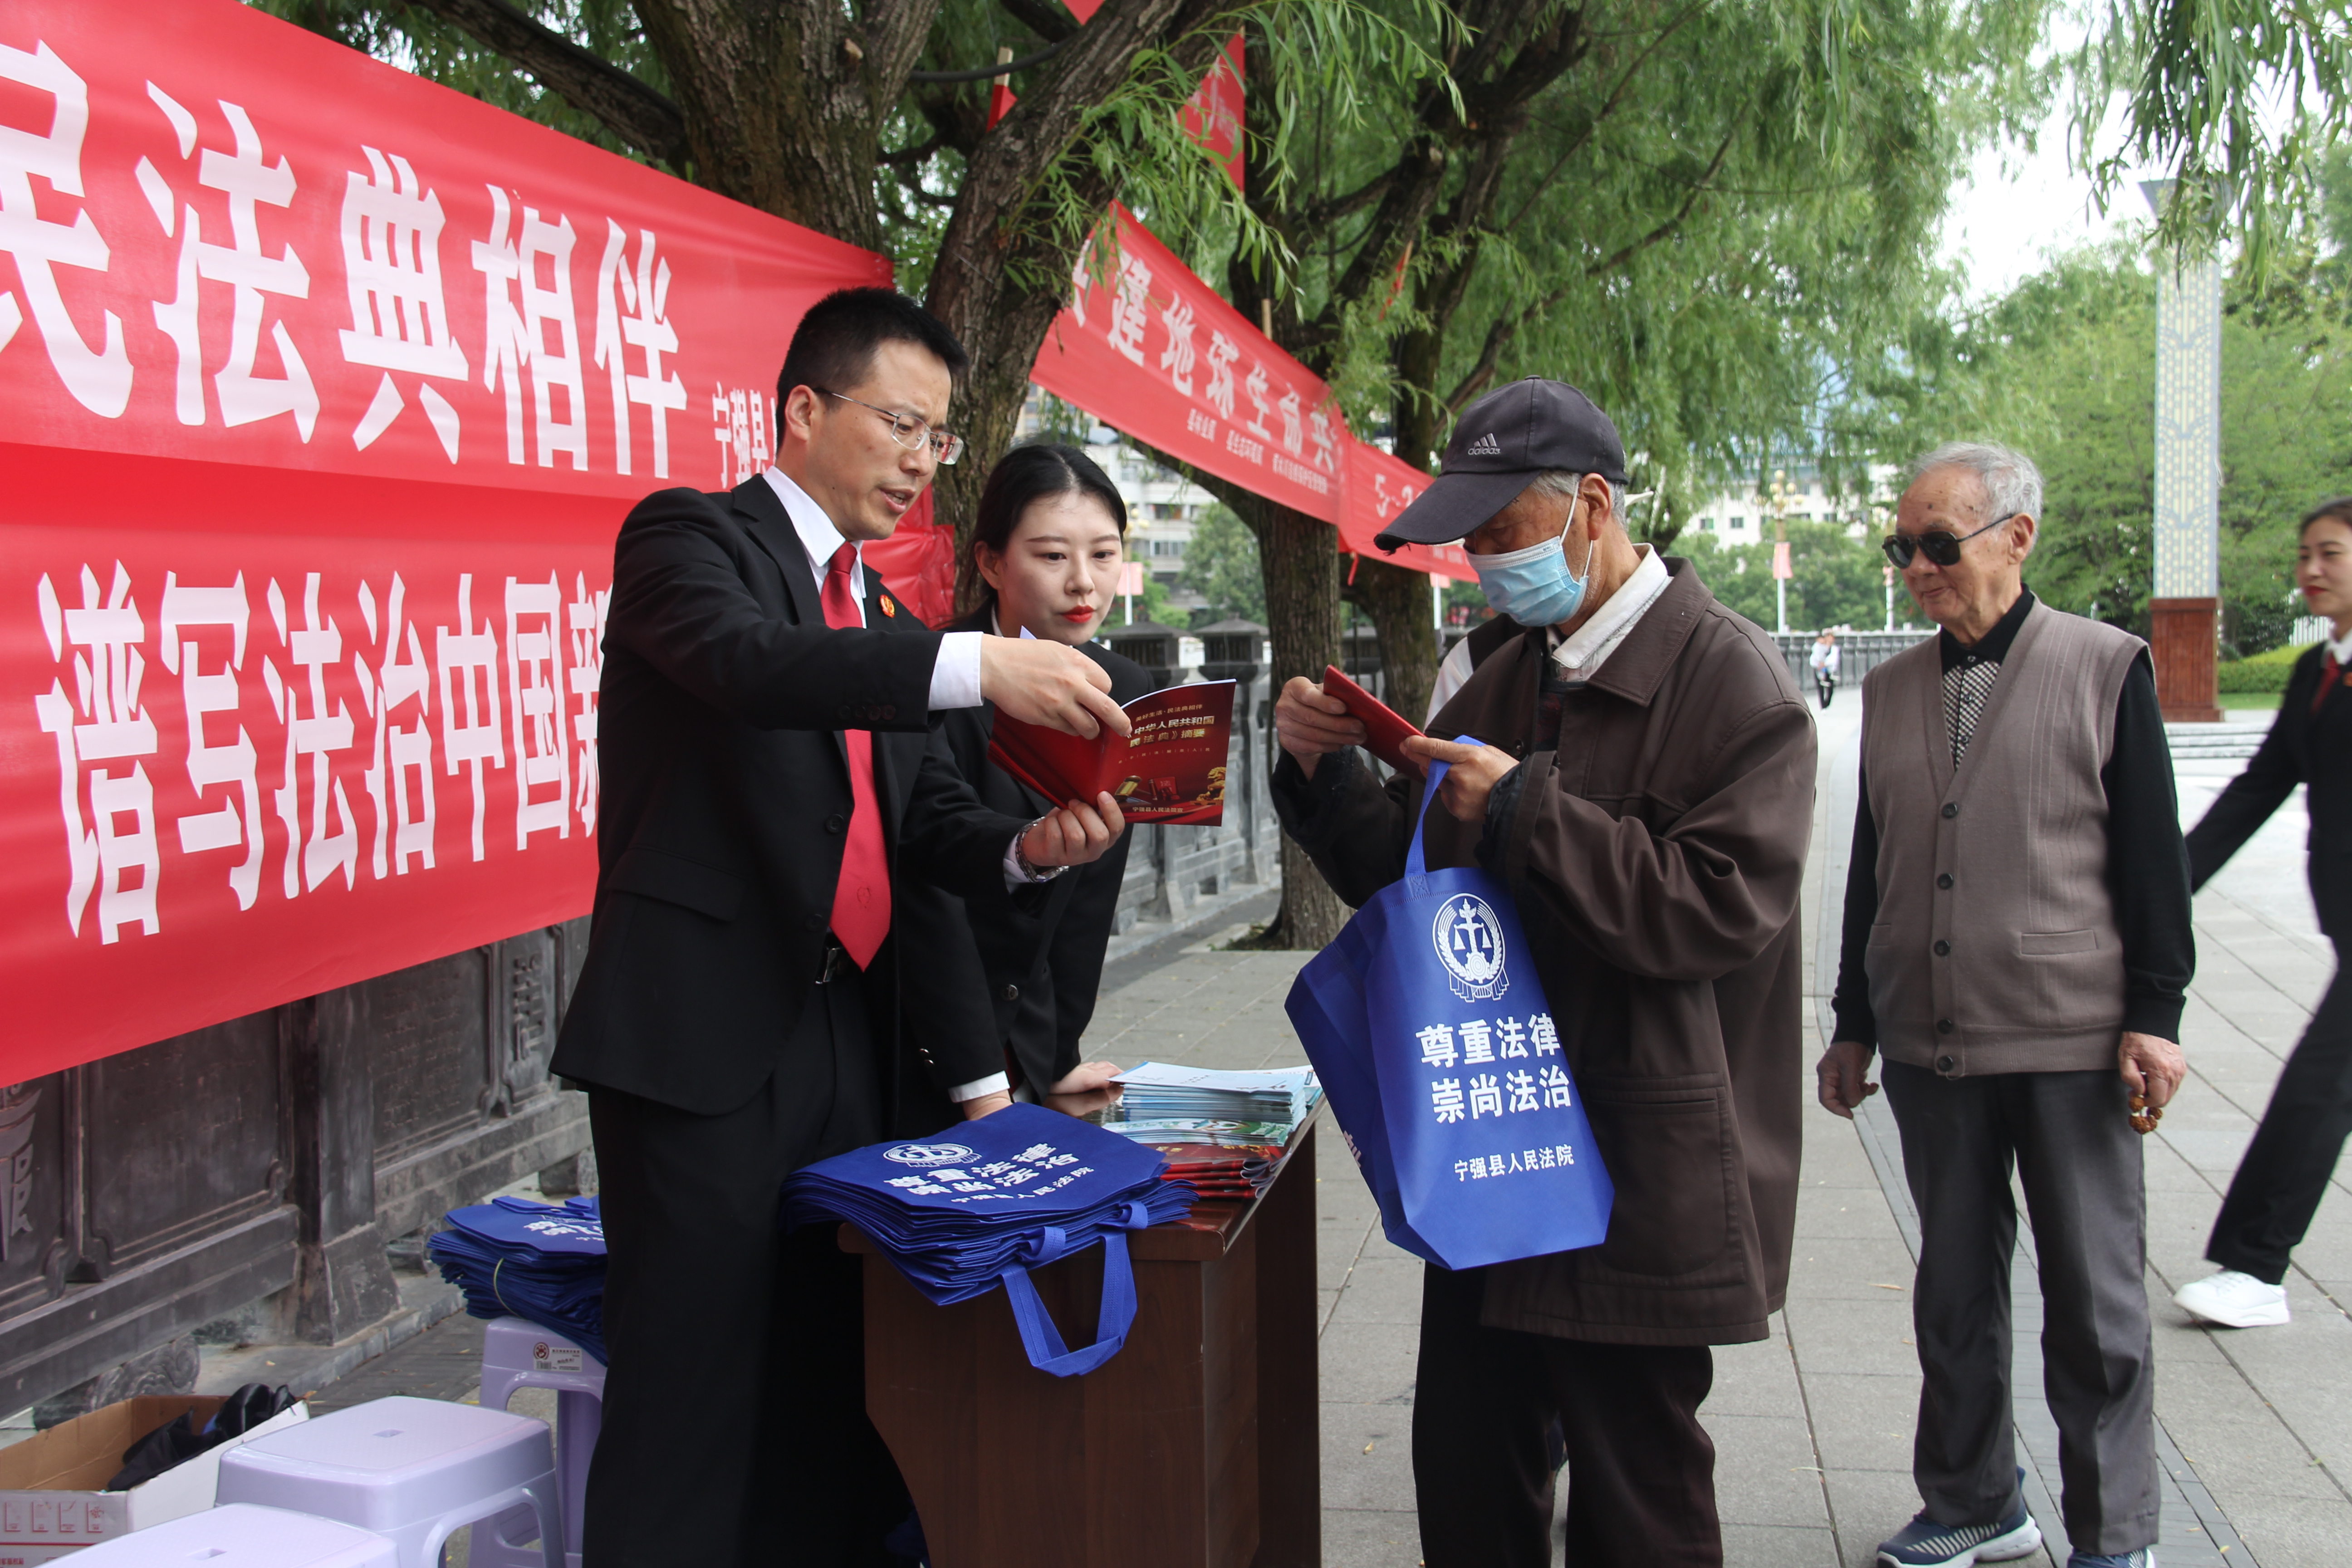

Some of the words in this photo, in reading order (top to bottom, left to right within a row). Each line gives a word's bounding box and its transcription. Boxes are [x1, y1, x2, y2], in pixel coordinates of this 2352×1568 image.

[0, 39, 687, 479] 民法典相伴
[1468, 446, 1501, 456] adidas
[1135, 704, 1203, 722] 美好生活·民法典相伴
[1415, 1013, 1561, 1068] 尊重法律
[1431, 1064, 1572, 1124] 崇尚法治
[1455, 1144, 1575, 1182] 宁强县人民法院
